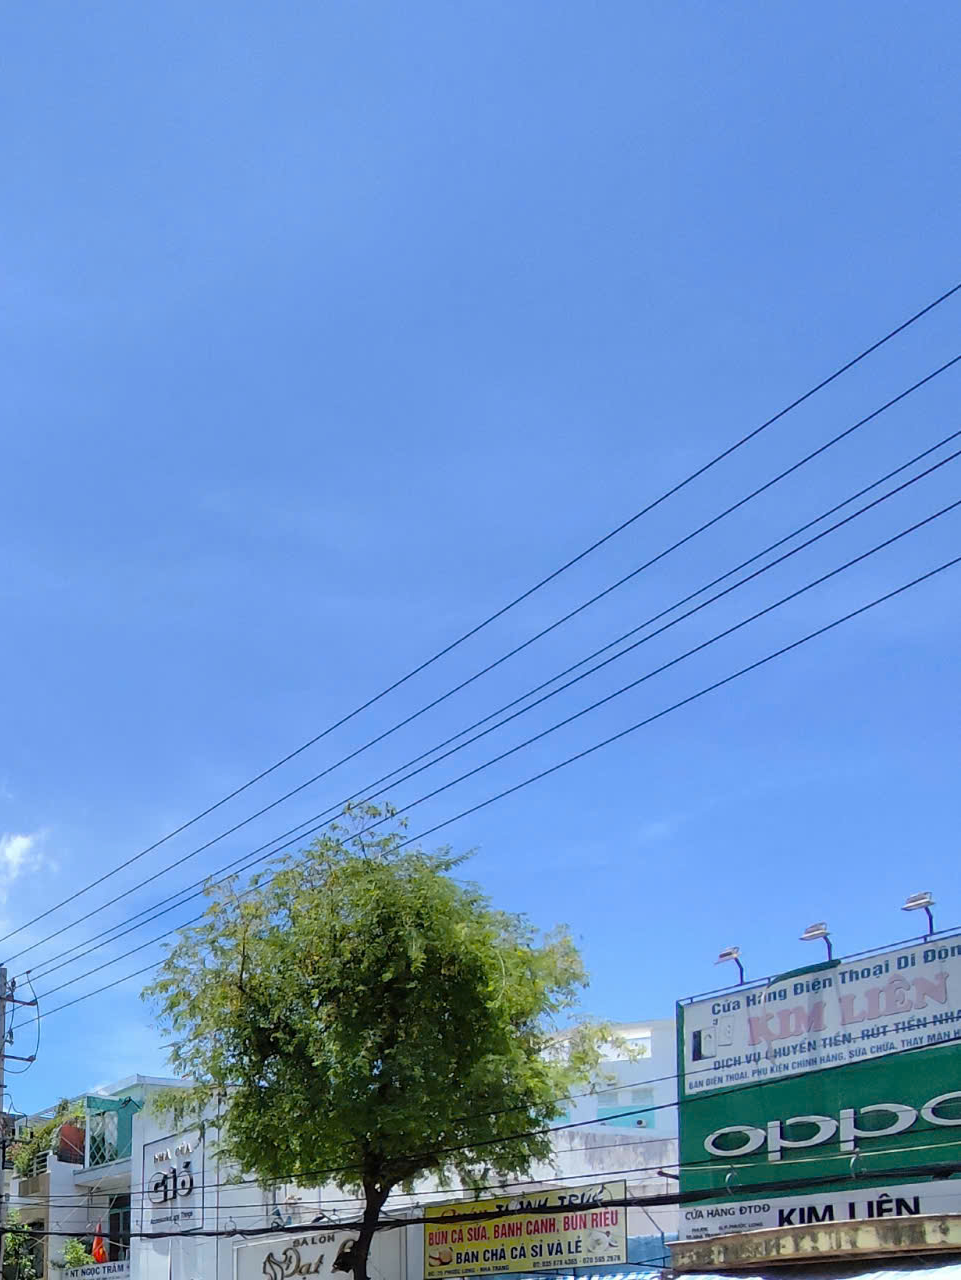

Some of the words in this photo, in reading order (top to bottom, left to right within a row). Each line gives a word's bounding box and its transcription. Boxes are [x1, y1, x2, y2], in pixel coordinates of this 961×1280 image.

[793, 977, 833, 995] Điện
[838, 960, 890, 984] Thoại
[897, 953, 916, 970] Di
[748, 1001, 827, 1046] KIM
[839, 972, 950, 1026] LIÊN
[861, 1024, 888, 1041] RÚT
[451, 1225, 464, 1243] CÁ
[493, 1220, 523, 1239] BÁNH
[563, 1212, 587, 1231] BÚN
[591, 1207, 618, 1228] RIÊU
[685, 1208, 704, 1220] CỬA
[707, 1206, 735, 1218] HÀNG
[739, 1203, 771, 1215] ĐTDĐ
[778, 1205, 834, 1227] KIM
[292, 1234, 335, 1248] SALON
[456, 1249, 479, 1264] BÁN
[483, 1243, 506, 1262] CHẢ
[510, 1243, 526, 1260] CÁ
[547, 1240, 563, 1256] VÀ
[568, 1235, 583, 1254] LẺ
